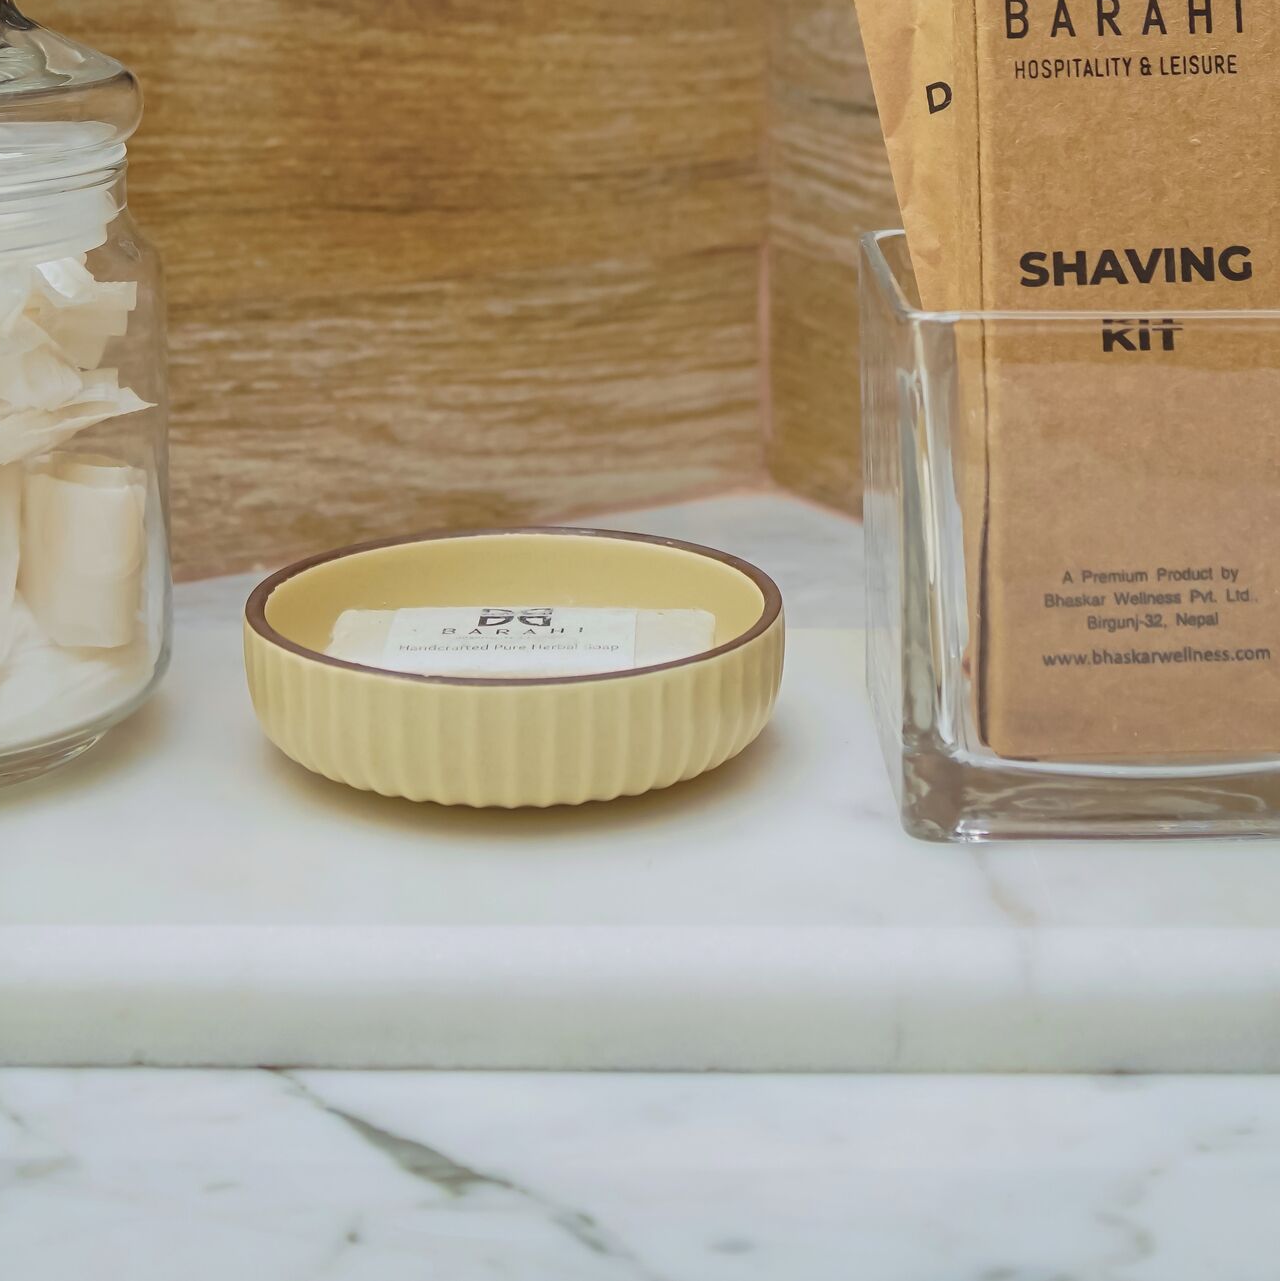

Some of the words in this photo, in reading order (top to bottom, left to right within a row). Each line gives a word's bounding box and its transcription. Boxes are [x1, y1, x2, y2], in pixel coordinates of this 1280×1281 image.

[1014, 57, 1132, 79] HOSPITALITY
[1140, 56, 1153, 75] &
[1160, 54, 1238, 76] LEISURE
[1019, 245, 1253, 288] SHAVING
[1102, 318, 1184, 352] KIT
[1062, 570, 1074, 585] A
[1081, 569, 1149, 584] Premium
[1156, 567, 1214, 582] Product
[1220, 566, 1240, 583] by
[1044, 593, 1106, 609] Bhaskar
[1113, 591, 1182, 606] Wellness
[1189, 588, 1218, 604] Pvt.
[1175, 611, 1219, 629] Nepal
[1042, 646, 1271, 667] www.bhaskarwellness.com
